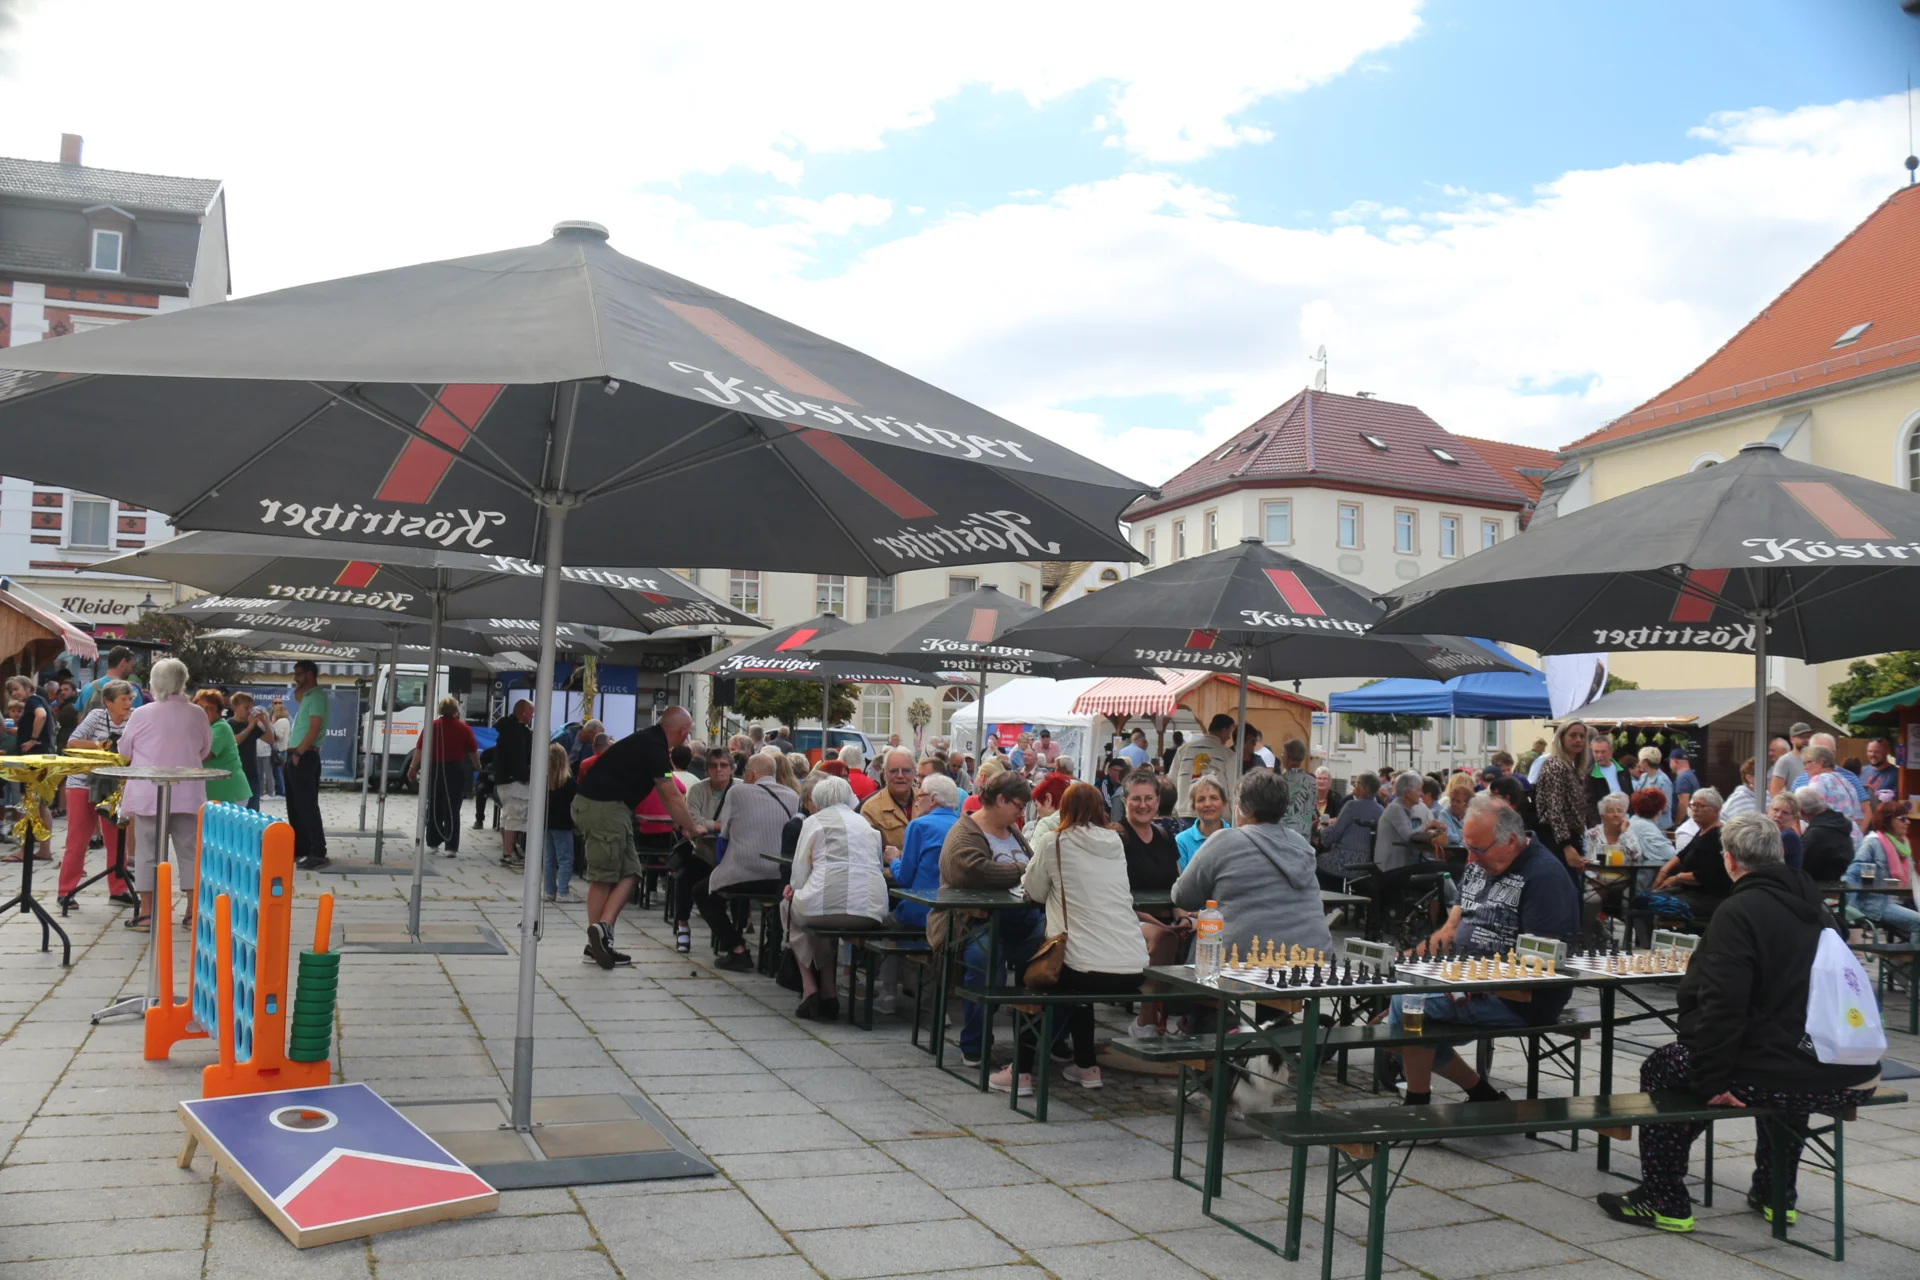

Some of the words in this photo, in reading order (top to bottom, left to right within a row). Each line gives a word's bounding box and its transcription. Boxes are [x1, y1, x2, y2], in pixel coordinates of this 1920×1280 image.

[668, 361, 1034, 463] Köstritzer
[60, 597, 135, 615] Kleider
[720, 655, 820, 672] Köstritzer
[1201, 922, 1218, 931] hella
